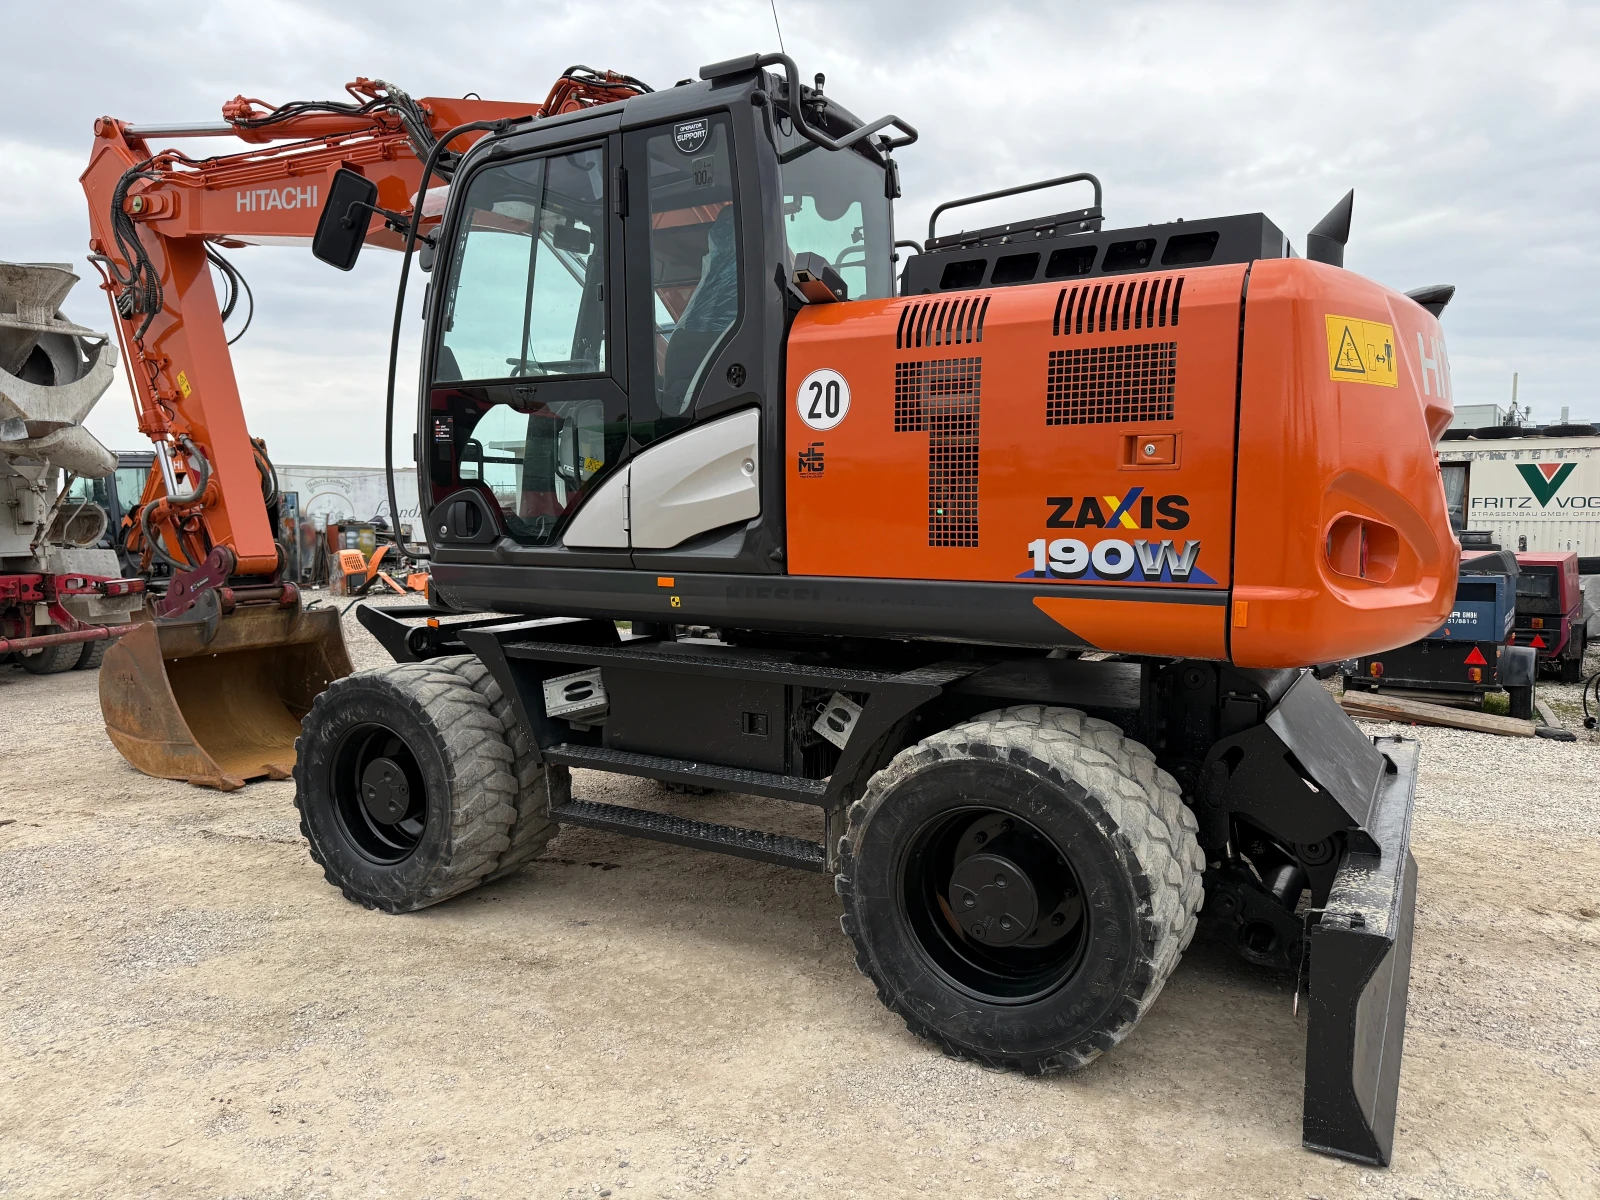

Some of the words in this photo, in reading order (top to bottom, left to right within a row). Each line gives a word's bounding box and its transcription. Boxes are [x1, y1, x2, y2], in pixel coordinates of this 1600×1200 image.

[677, 130, 706, 142] SUPPORT
[679, 122, 702, 132] OPERATOR
[694, 169, 707, 186] 100
[236, 185, 318, 213] HITACHI
[807, 380, 840, 419] 20
[1046, 486, 1191, 531] ZAXIS
[1471, 496, 1532, 509] FRITZ
[1555, 496, 1600, 509] VOG
[1027, 538, 1202, 583] 190W
